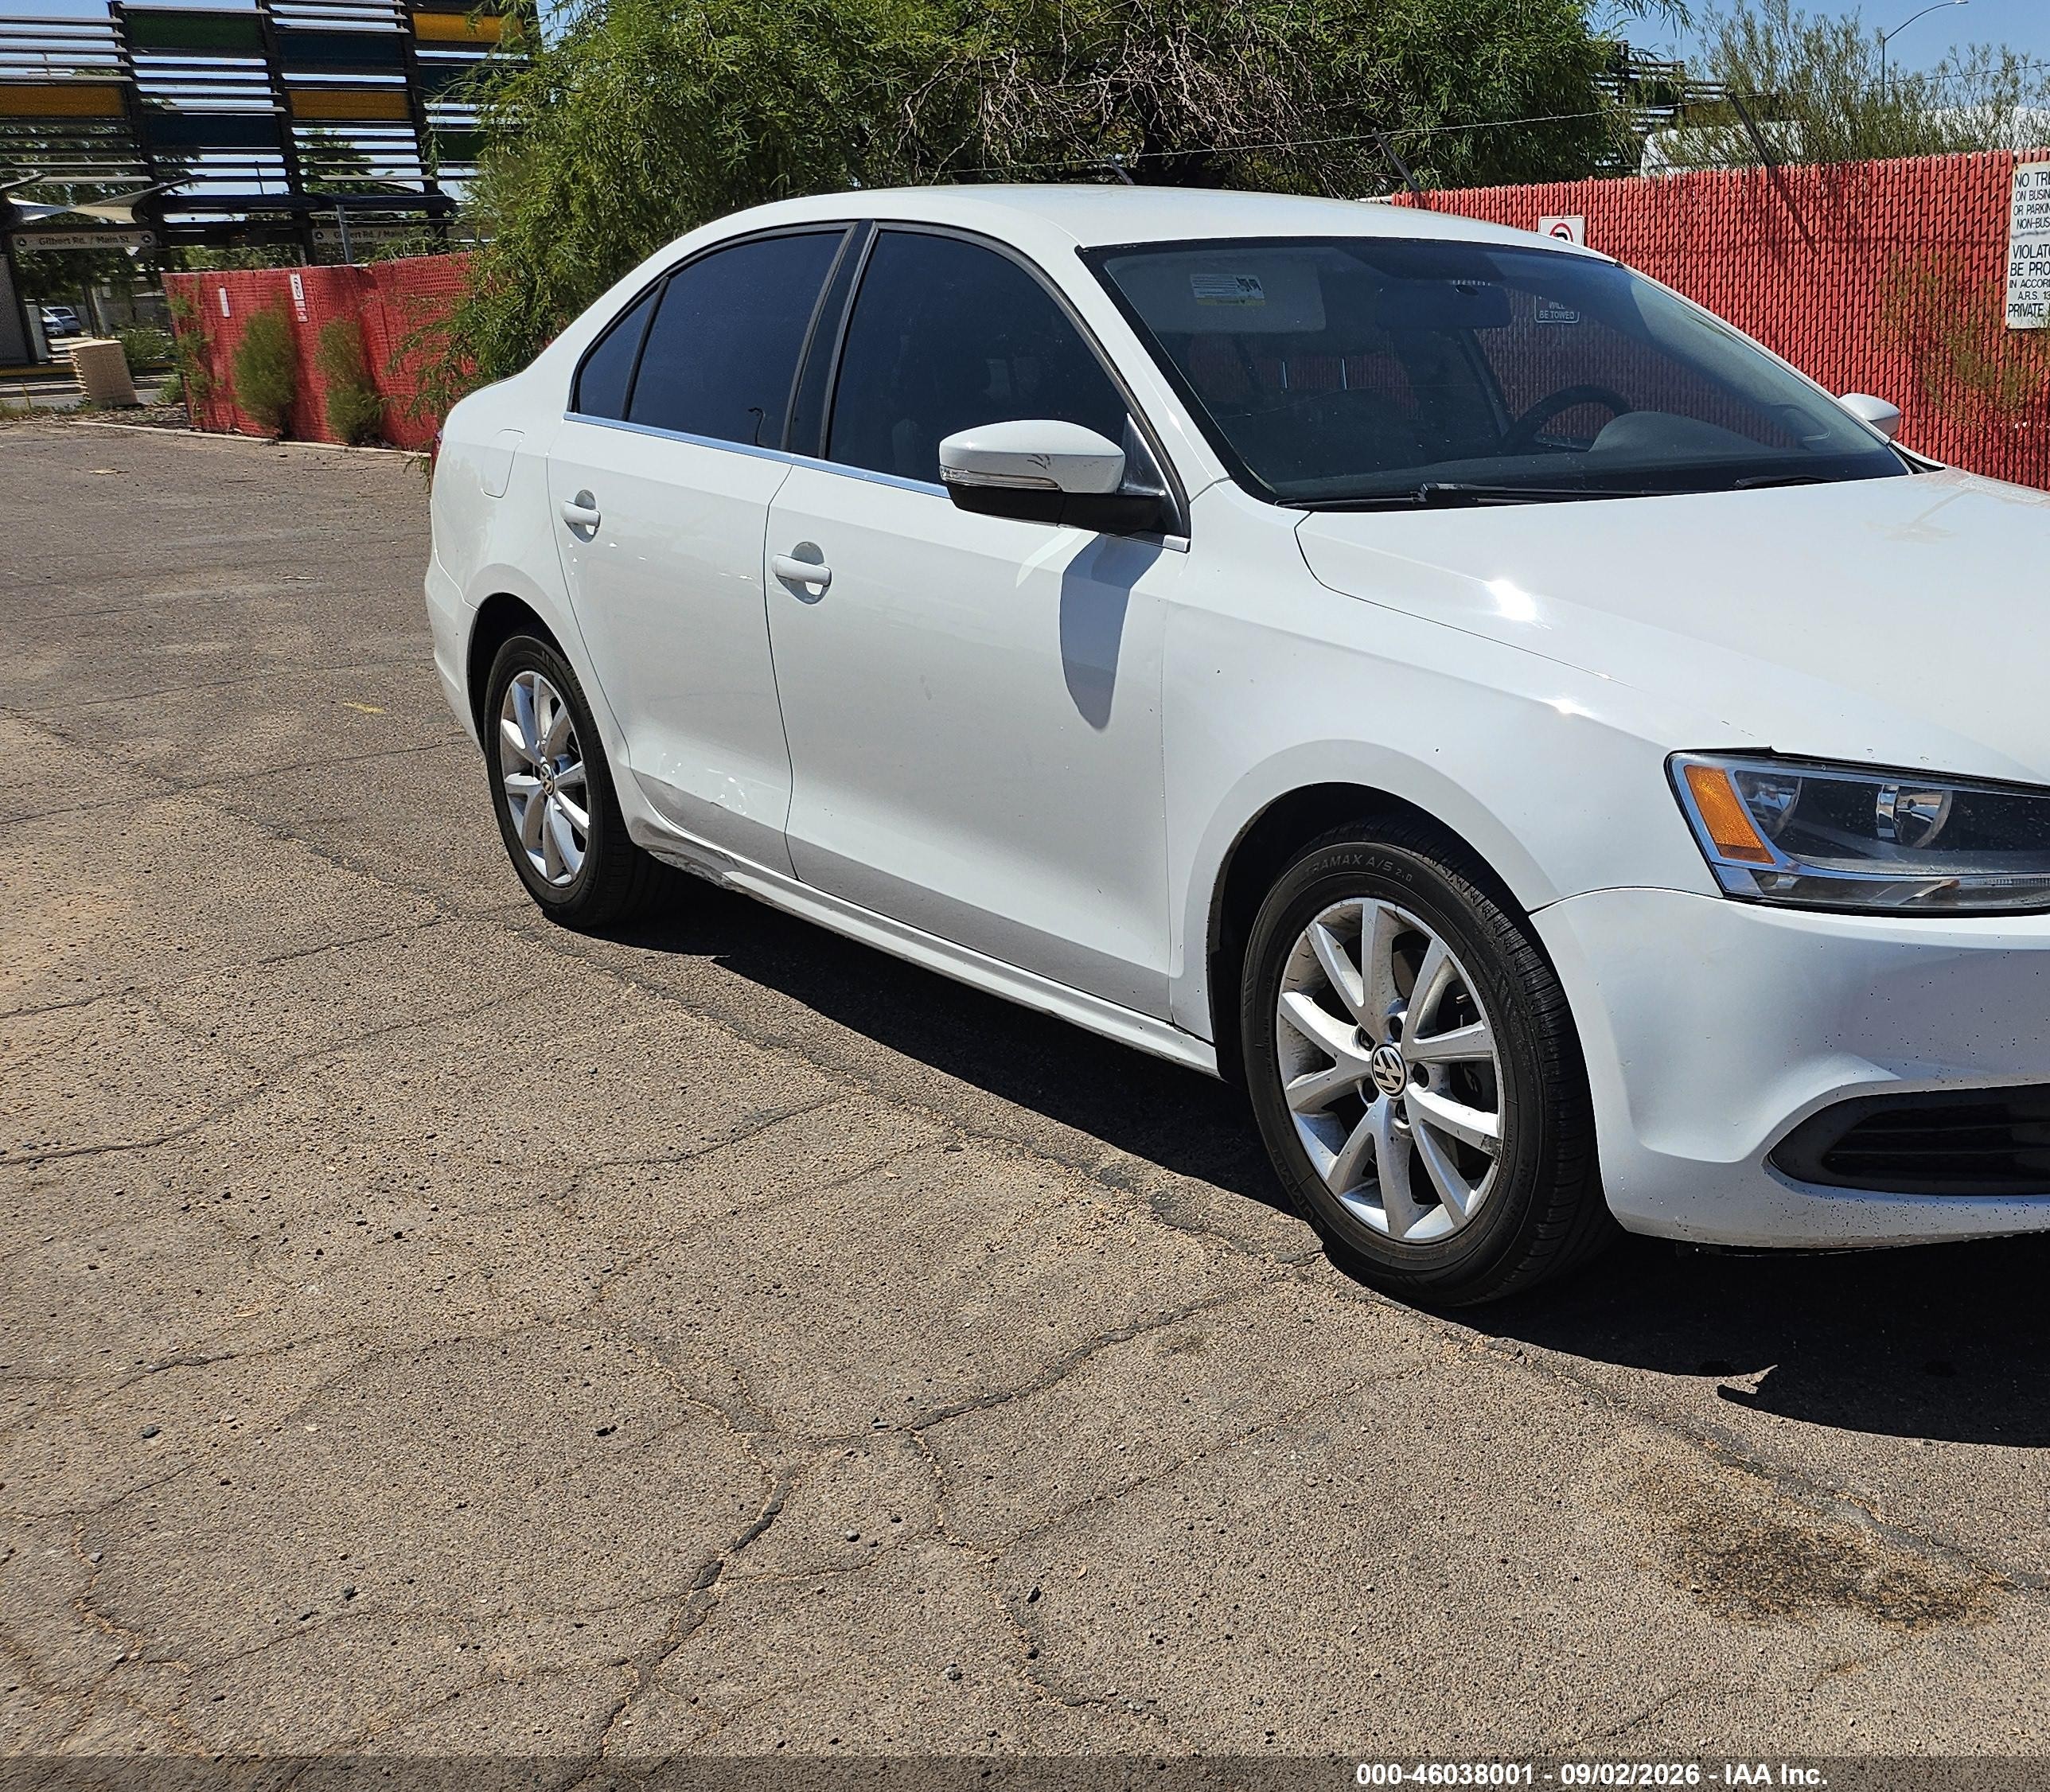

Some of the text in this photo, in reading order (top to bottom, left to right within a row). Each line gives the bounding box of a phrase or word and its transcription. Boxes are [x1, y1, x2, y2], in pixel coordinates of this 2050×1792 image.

[2014, 172, 2030, 188] NO
[2016, 190, 2026, 202] ON
[2013, 205, 2024, 216] OR
[2013, 243, 2050, 259] VIOLAT
[2009, 260, 2050, 276] BE PRO
[2009, 279, 2017, 288] IN
[1539, 310, 1575, 319] BE TOWED
[2008, 303, 2044, 317] PRIVATE
[1366, 856, 1393, 872] A/S
[1395, 867, 1413, 882] 2.0
